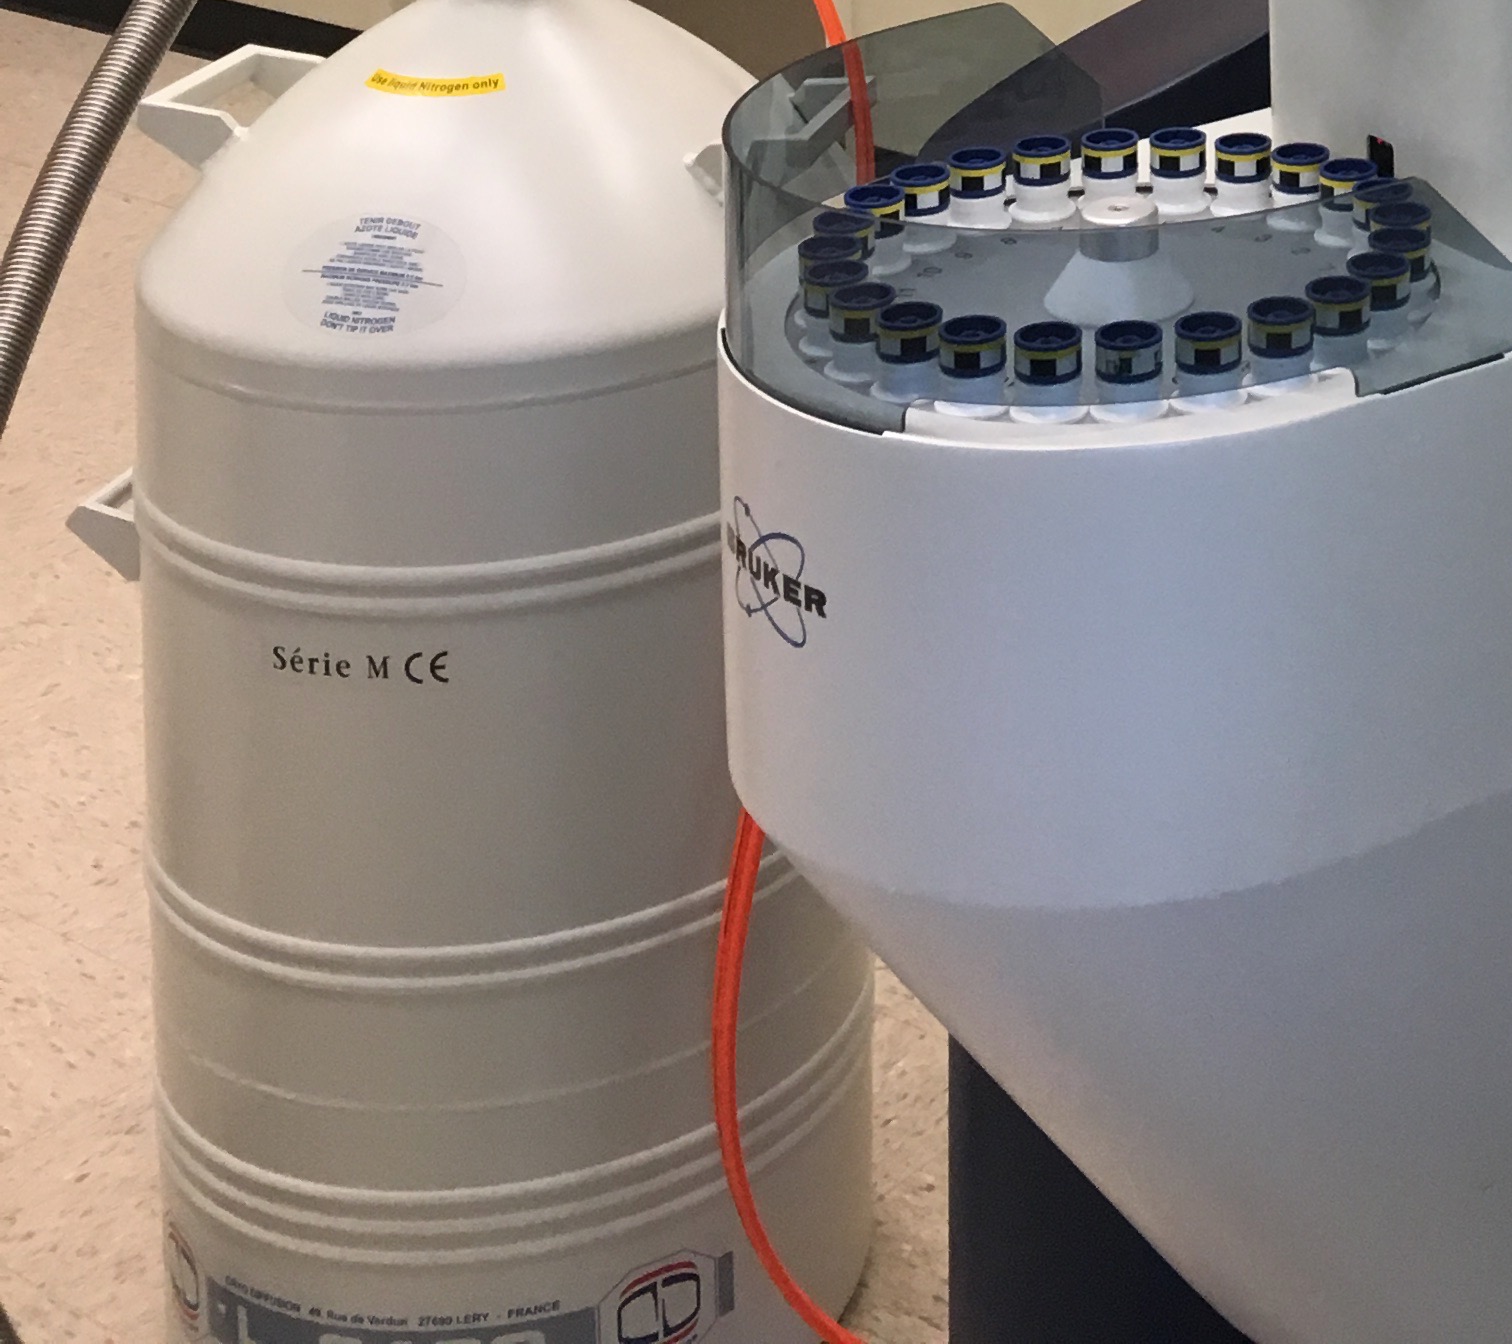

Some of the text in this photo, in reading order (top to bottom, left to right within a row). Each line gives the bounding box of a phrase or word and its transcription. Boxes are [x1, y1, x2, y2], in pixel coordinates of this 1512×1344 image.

[371, 72, 388, 86] Use
[419, 81, 469, 94] Nitrogen
[472, 77, 500, 89] only
[272, 645, 351, 679] Série
[366, 655, 391, 679] M
[507, 1299, 561, 1319] FRANCE
